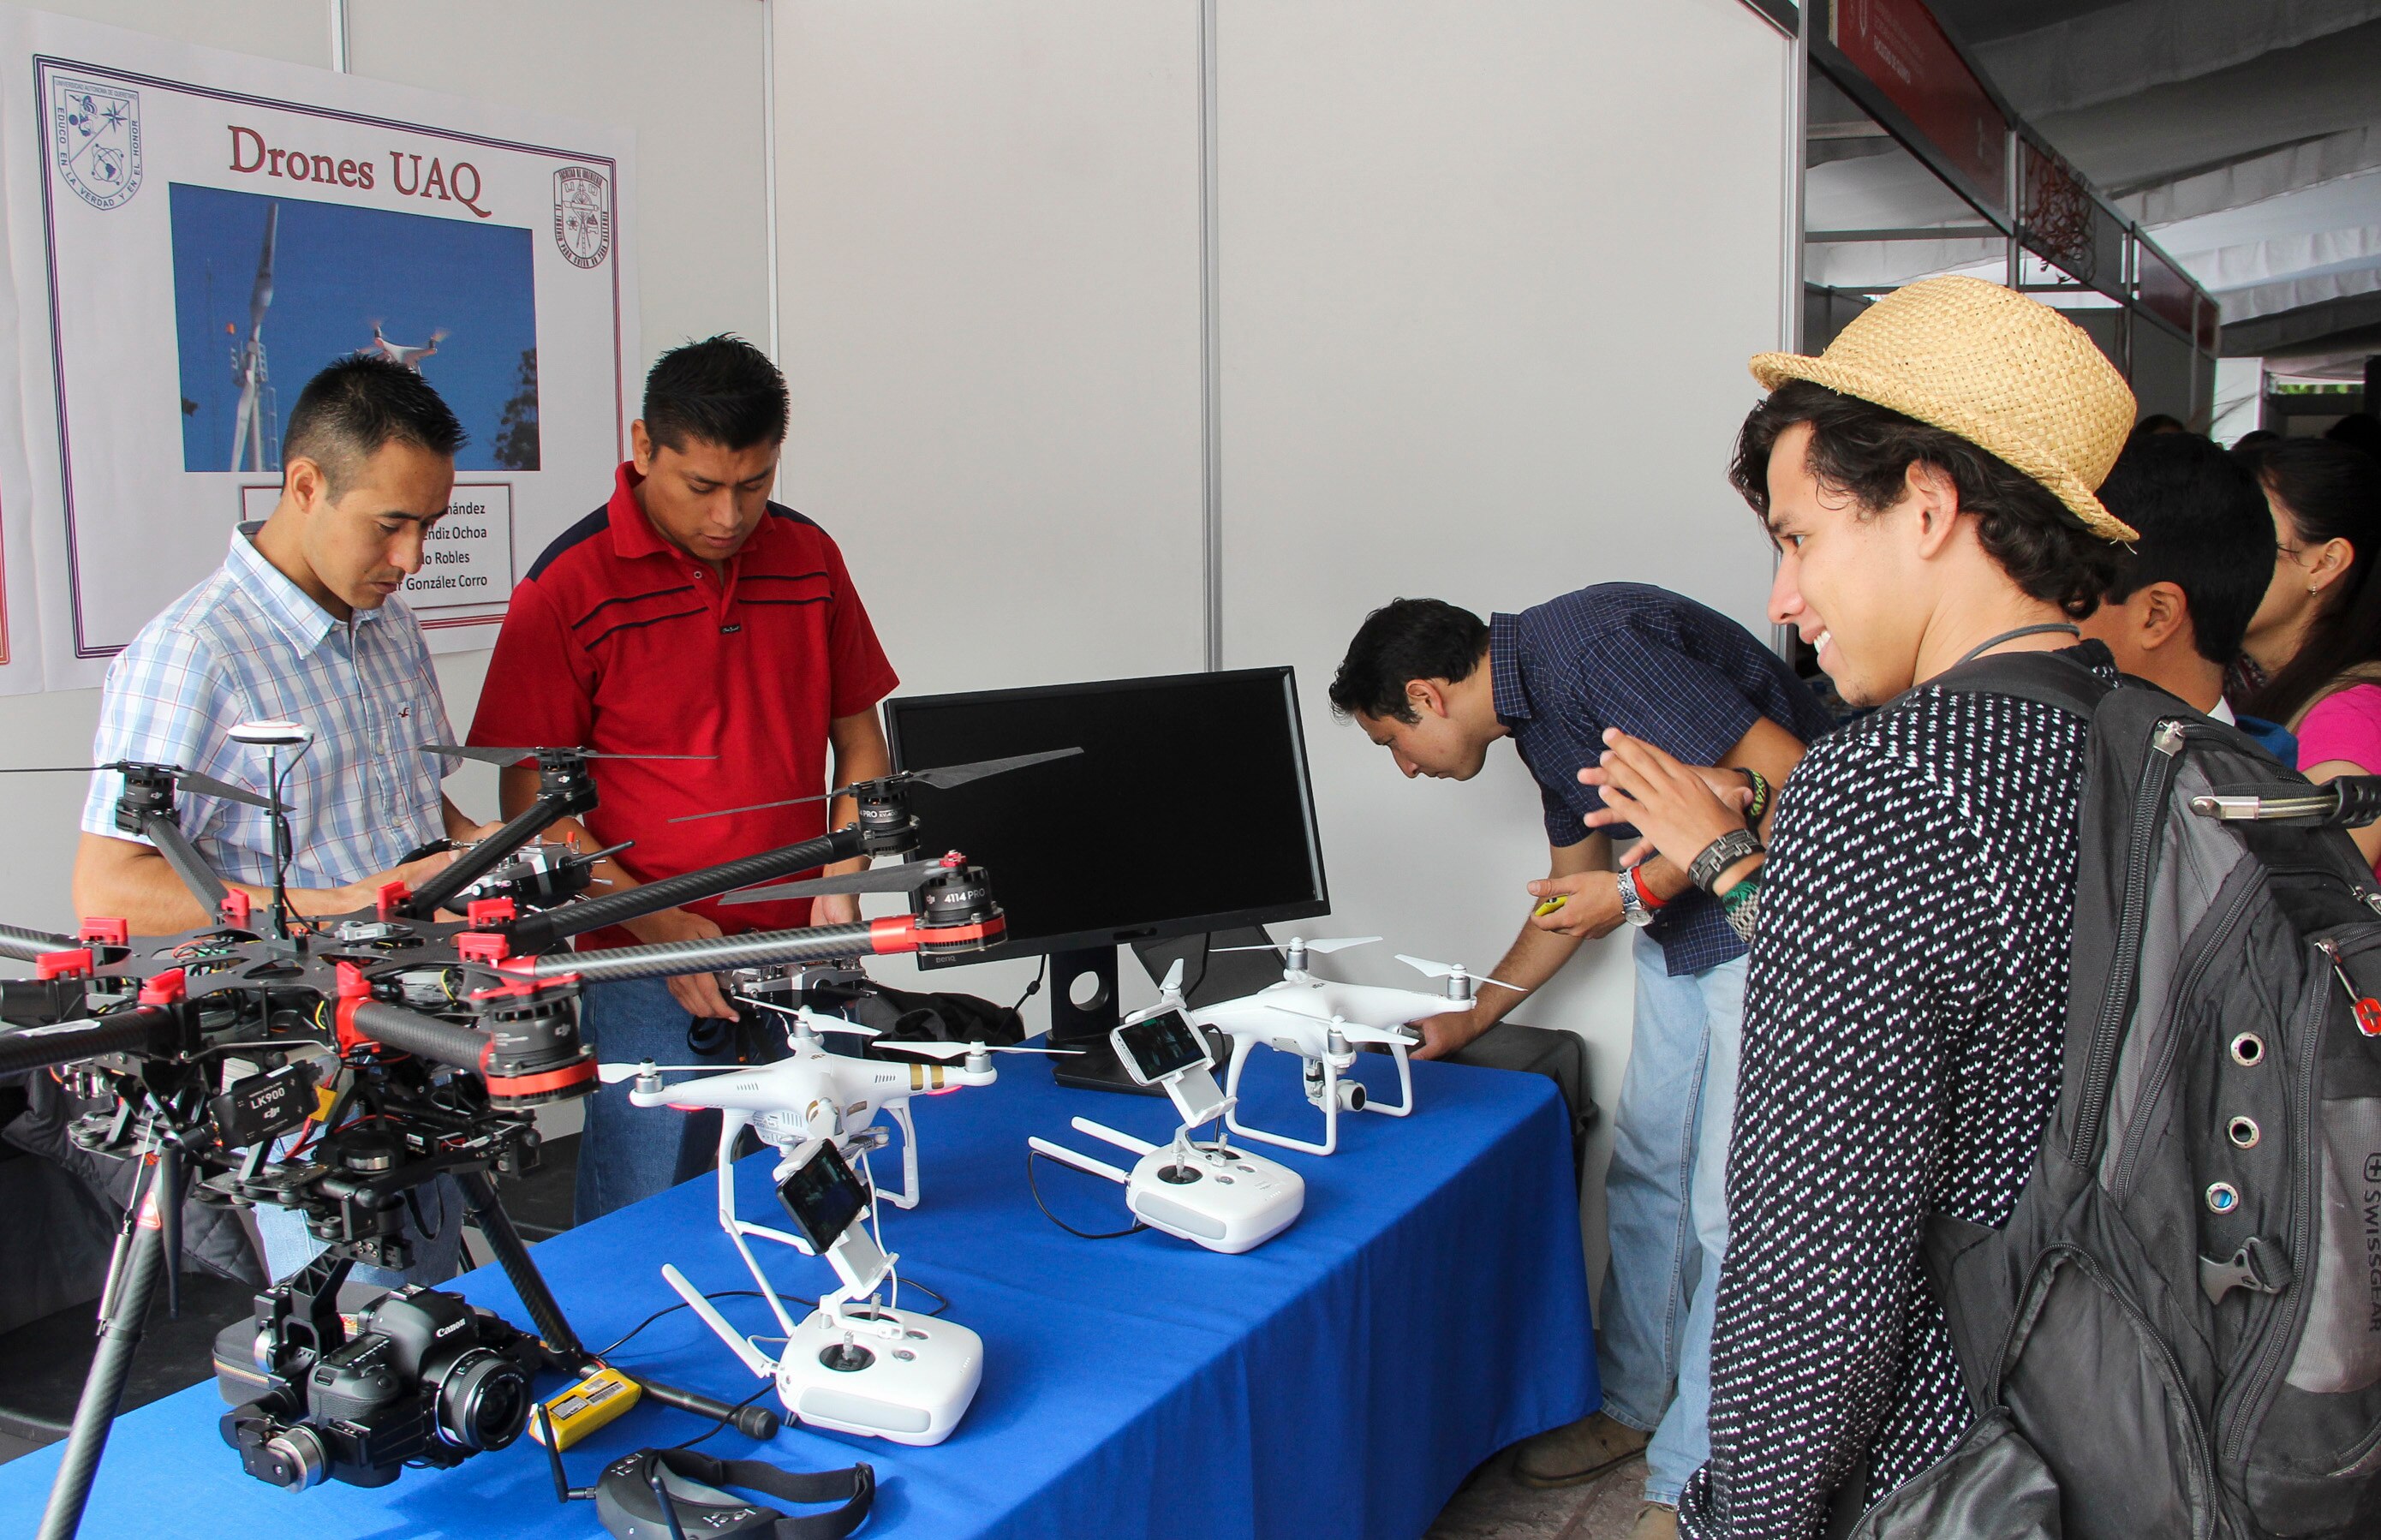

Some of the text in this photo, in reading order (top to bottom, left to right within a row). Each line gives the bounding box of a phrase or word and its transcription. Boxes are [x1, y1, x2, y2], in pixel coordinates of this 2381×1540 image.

[57, 107, 67, 144] EDUCO
[131, 120, 140, 157] HONOR
[60, 152, 69, 166] EN
[133, 163, 140, 176] EL
[227, 125, 492, 218] Drones UAQ
[65, 171, 76, 186] LA
[127, 181, 138, 193] EN
[80, 187, 115, 207] VERDAD
[448, 502, 486, 515] nández
[452, 526, 487, 538] Ochoa
[435, 551, 470, 564] Robles
[406, 575, 457, 591] González
[458, 575, 487, 588] Corro
[862, 809, 878, 818] PRO
[944, 892, 967, 904] 4114
[967, 888, 986, 900] PRO
[250, 1087, 285, 1110] LK900
[2364, 1190, 2381, 1333] SWISSGEAR
[436, 1317, 466, 1338] Canon
